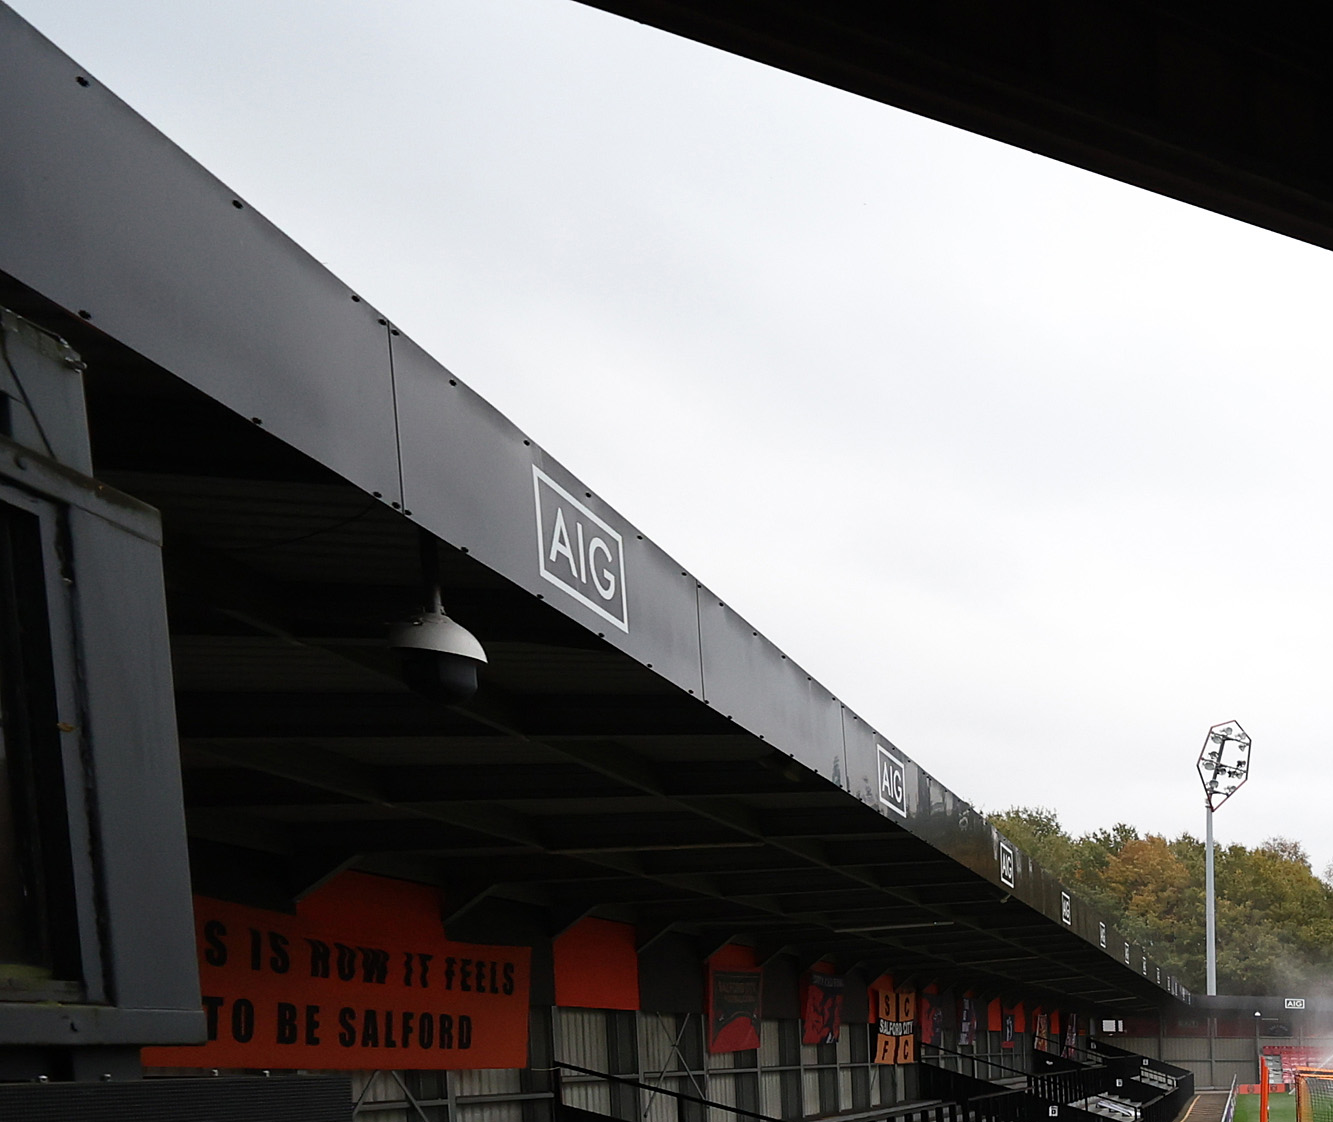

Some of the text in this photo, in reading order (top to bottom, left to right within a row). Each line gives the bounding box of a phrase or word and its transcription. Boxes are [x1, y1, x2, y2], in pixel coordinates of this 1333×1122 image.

[549, 506, 617, 602] AIG
[881, 761, 903, 803] AIG
[250, 928, 290, 974] IS
[304, 938, 390, 985] HOW
[403, 952, 433, 989] IT
[445, 957, 515, 996] FEELS
[203, 997, 472, 1050] TO BE SALFORD
[884, 994, 910, 1017] S C
[879, 1019, 913, 1036] SALFORD CITY
[882, 1039, 909, 1060] F C
